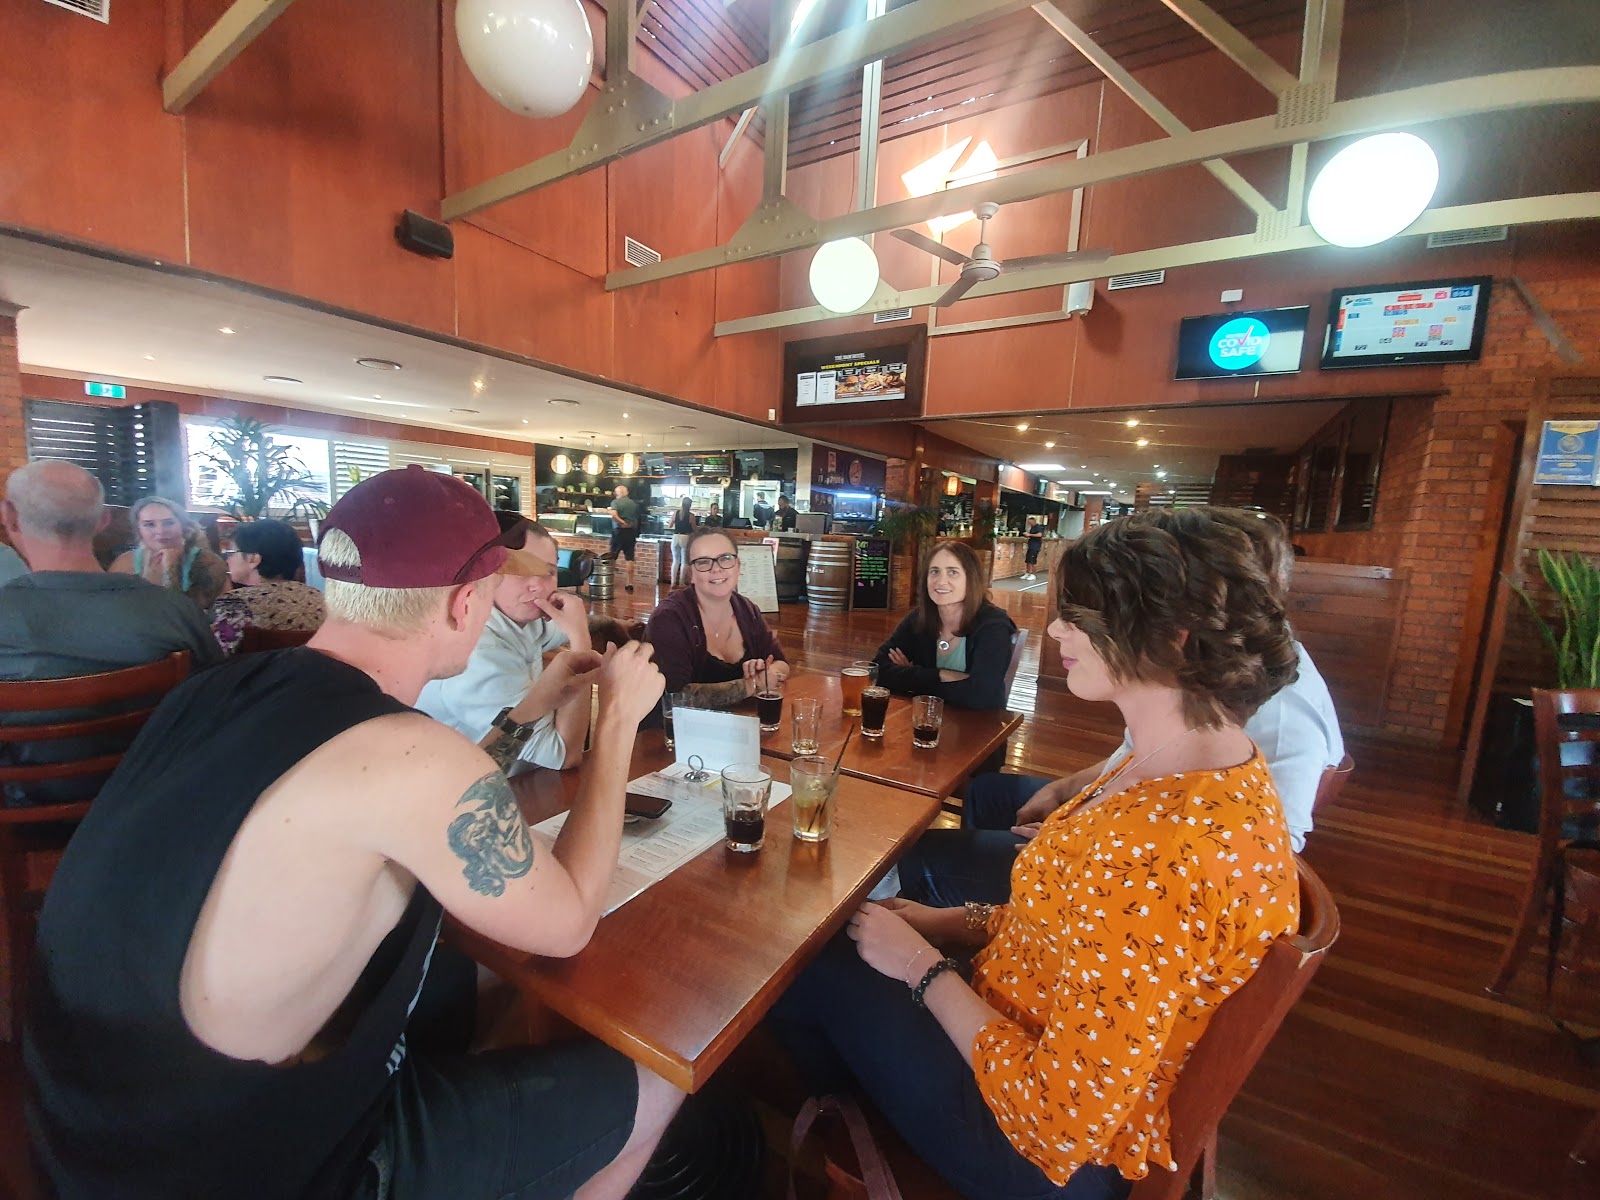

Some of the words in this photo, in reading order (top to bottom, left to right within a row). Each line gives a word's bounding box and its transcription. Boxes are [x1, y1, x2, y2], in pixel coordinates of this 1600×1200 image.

[1217, 333, 1263, 349] COVID
[1220, 346, 1256, 358] SAFE
[854, 359, 880, 367] SPECIALS
